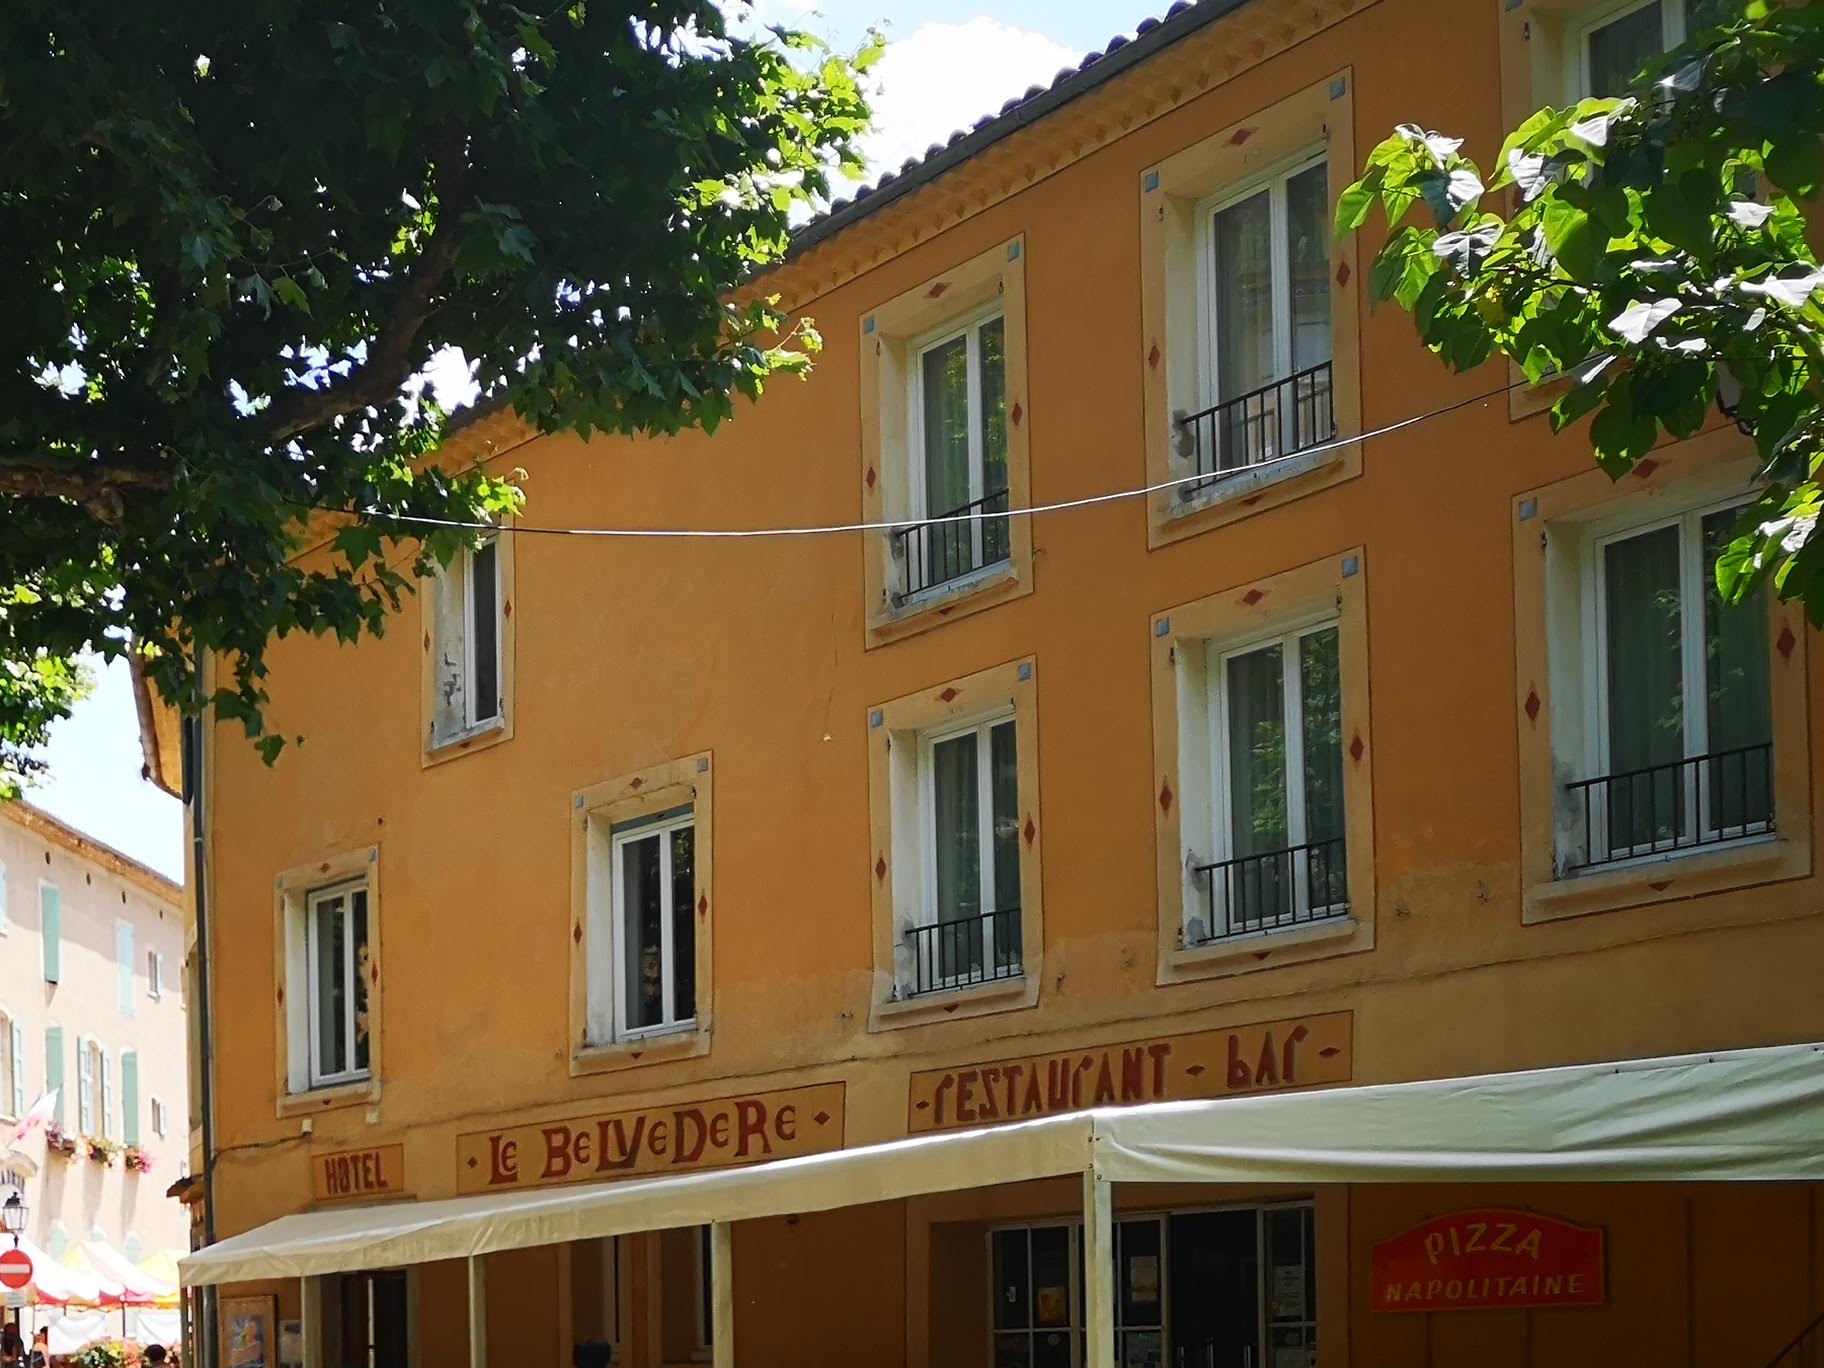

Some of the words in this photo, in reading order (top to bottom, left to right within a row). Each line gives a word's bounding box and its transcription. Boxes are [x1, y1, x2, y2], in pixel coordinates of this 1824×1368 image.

[324, 1151, 389, 1195] HOTEL
[1424, 1222, 1543, 1264] PIZZA
[1385, 1274, 1585, 1302] NAPOLITAINE
